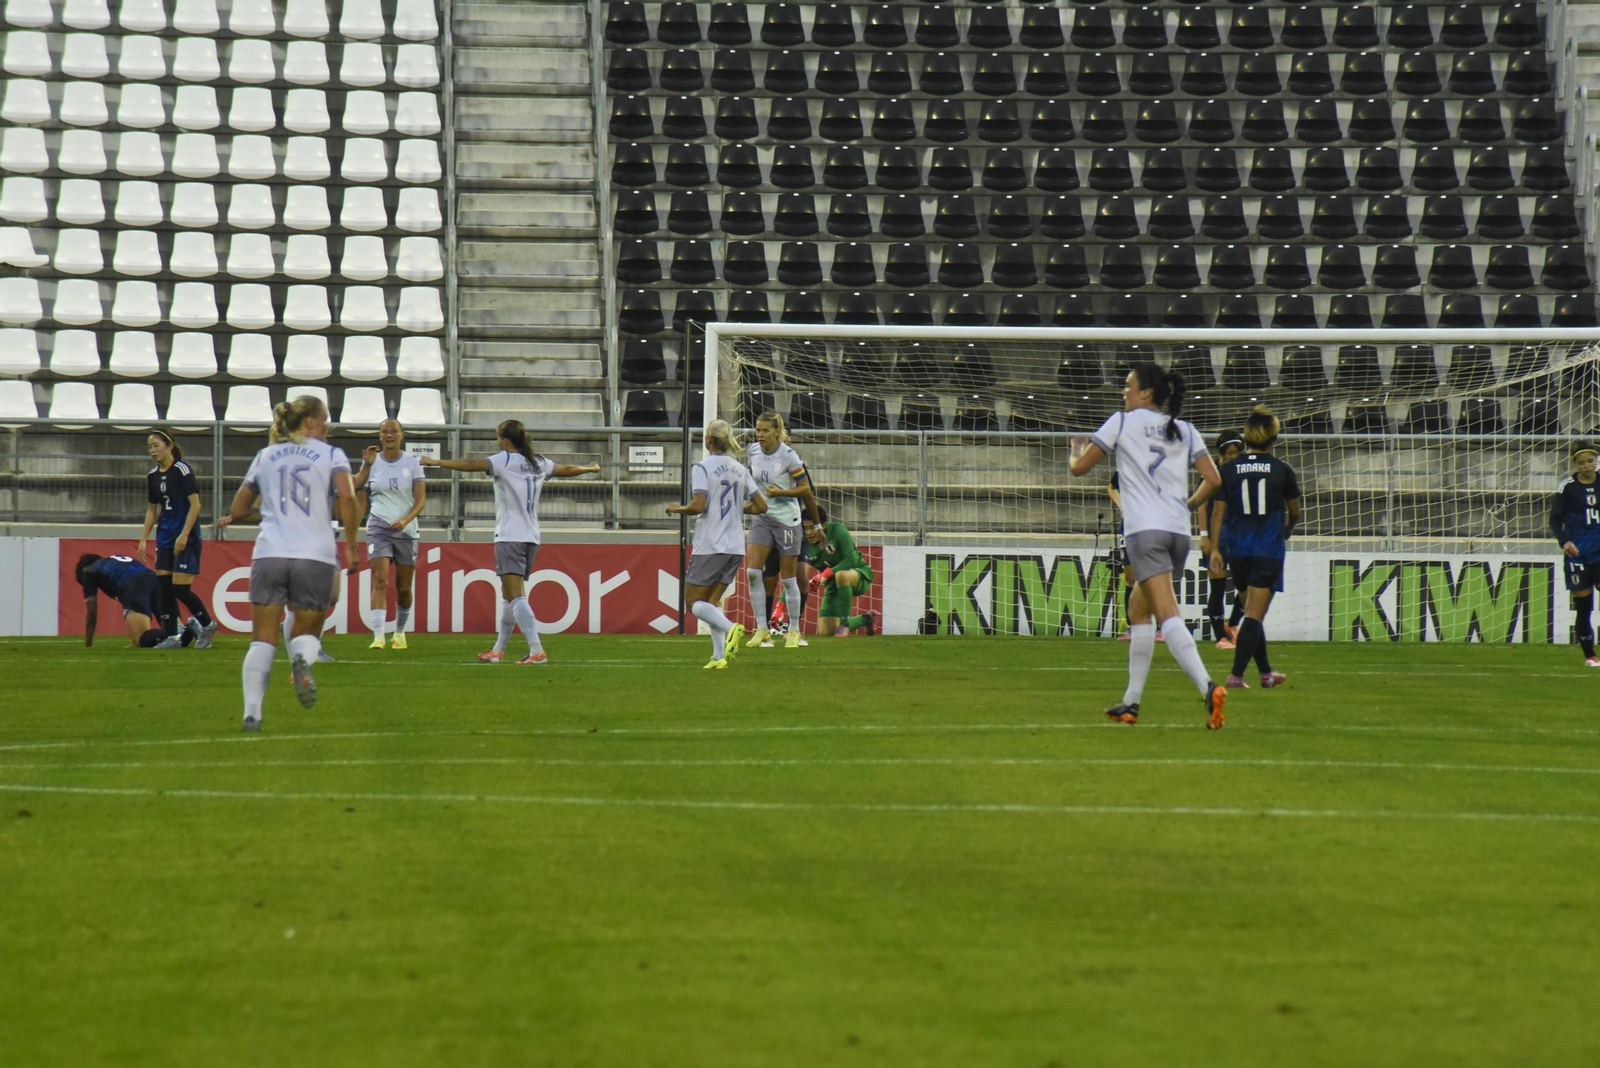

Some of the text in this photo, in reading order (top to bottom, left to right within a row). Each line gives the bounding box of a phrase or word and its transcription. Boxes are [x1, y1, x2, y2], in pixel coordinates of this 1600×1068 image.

[1148, 445, 1167, 494] 7
[1235, 462, 1271, 474] TANAKA
[162, 495, 173, 511] 2
[276, 464, 311, 517] 16
[524, 476, 538, 514] 11
[720, 479, 739, 521] 21
[1241, 478, 1266, 515] 11
[1586, 507, 1600, 525] 14
[783, 529, 794, 544] 14
[1328, 559, 1555, 643] KIWI
